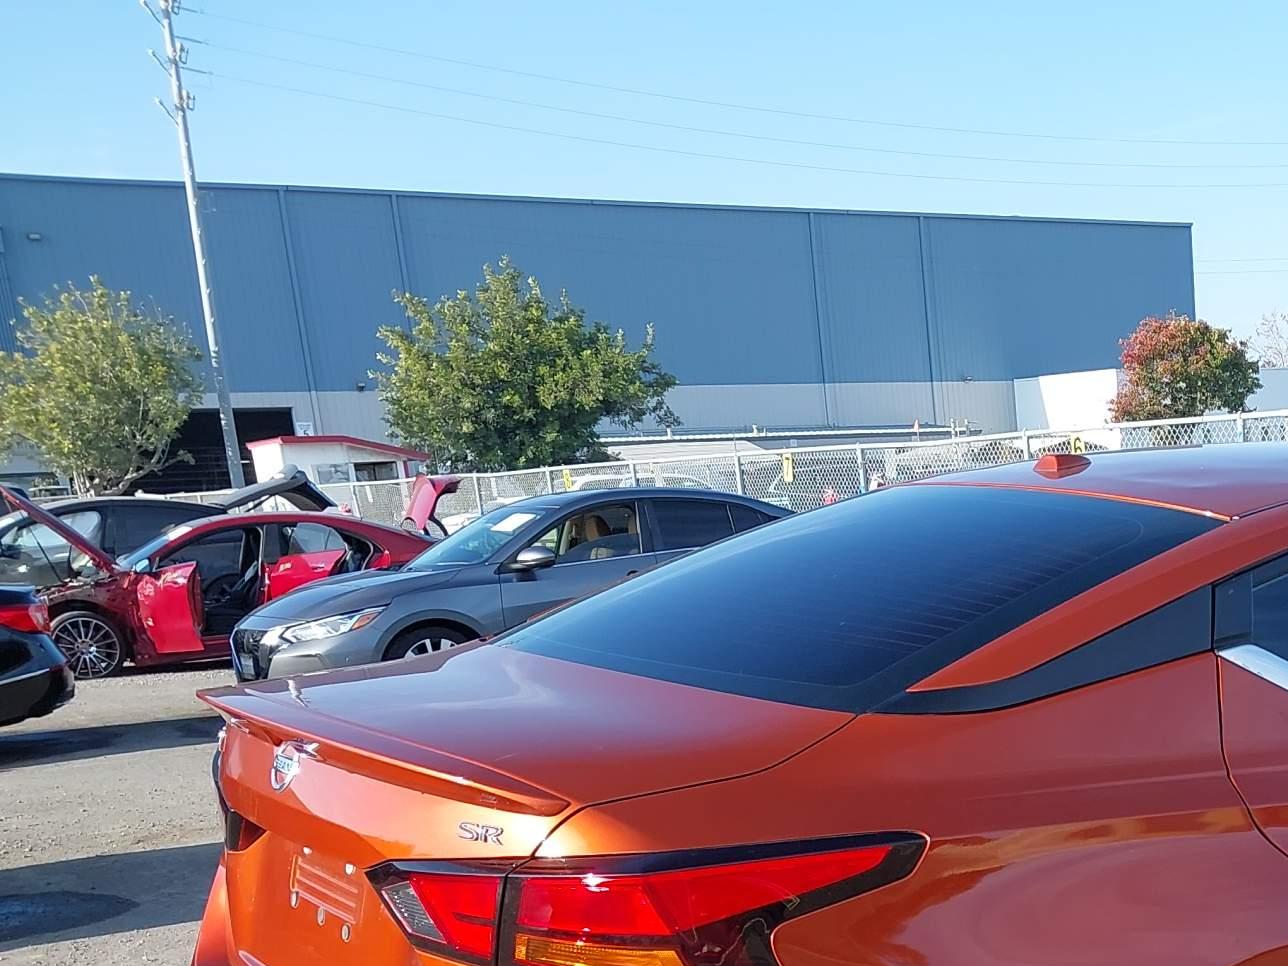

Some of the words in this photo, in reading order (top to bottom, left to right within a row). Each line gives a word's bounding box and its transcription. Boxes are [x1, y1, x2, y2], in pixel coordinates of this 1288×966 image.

[1073, 436, 1083, 453] 6
[784, 456, 791, 478] 7
[458, 821, 504, 845] SR
